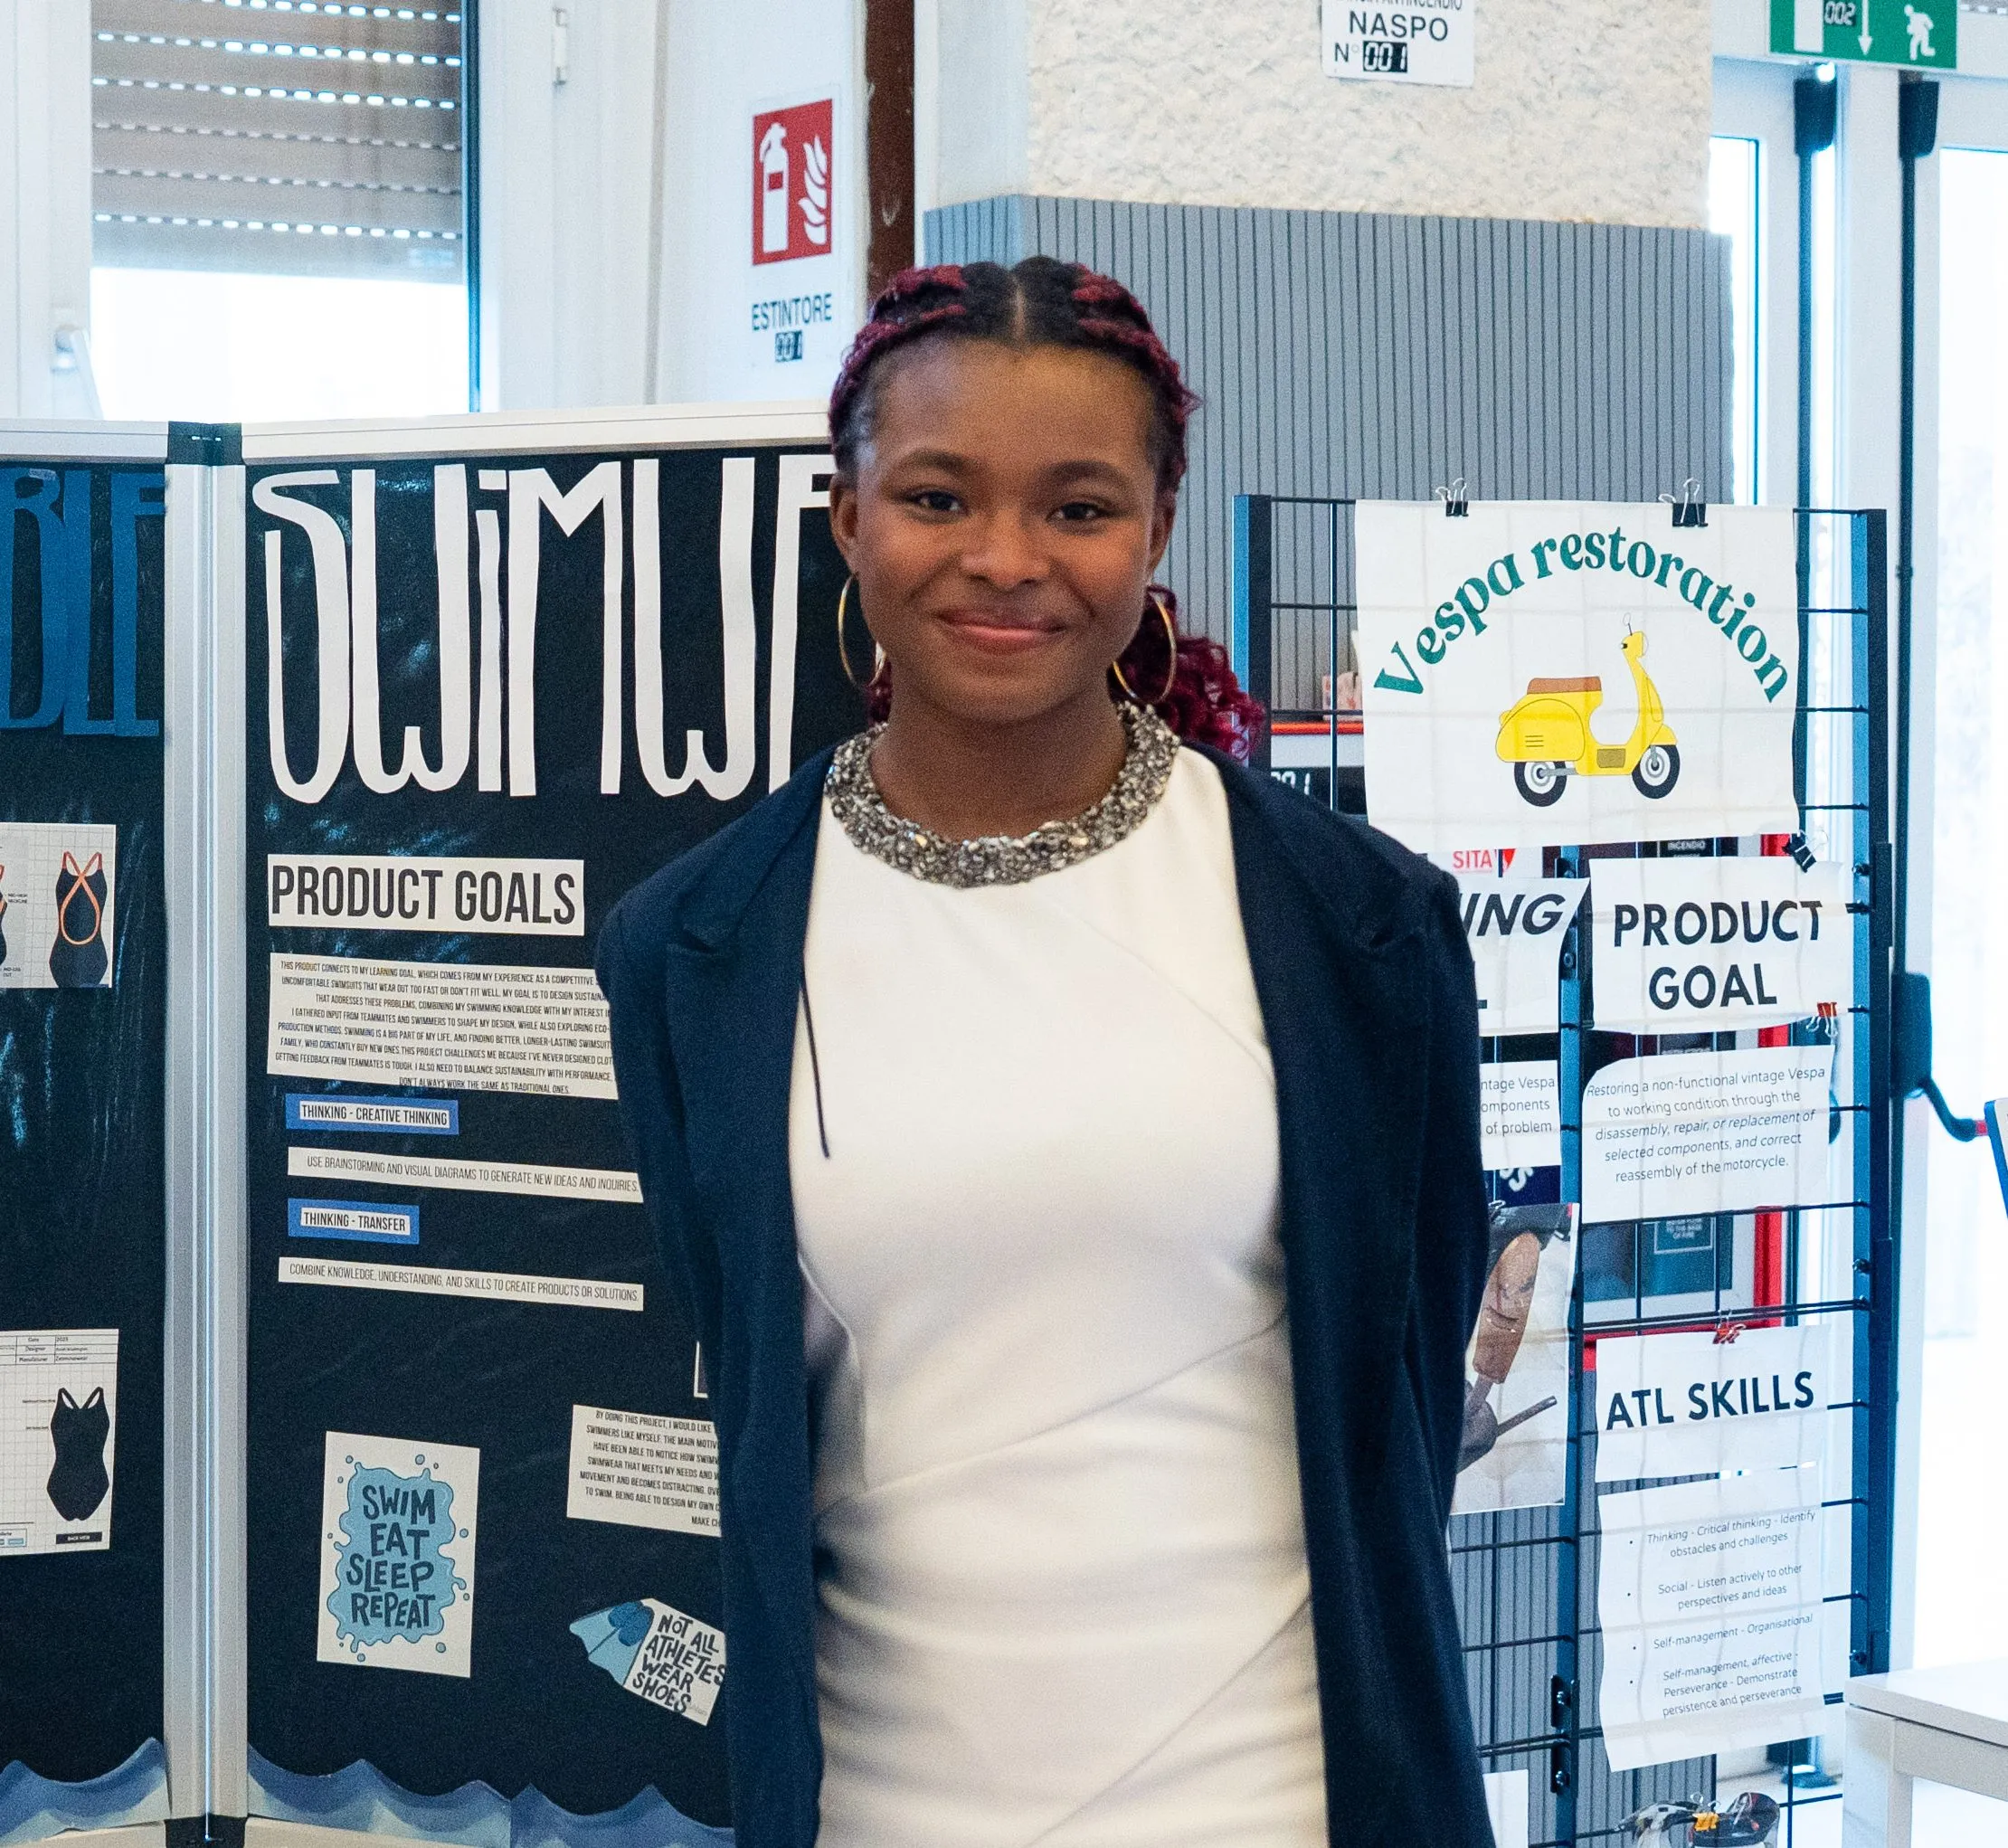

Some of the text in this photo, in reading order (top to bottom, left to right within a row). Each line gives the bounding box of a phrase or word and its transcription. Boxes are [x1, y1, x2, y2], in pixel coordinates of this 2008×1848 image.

[1350, 11, 1448, 42] NASPO
[1824, 1, 1856, 25] 002
[1364, 42, 1407, 72] 001
[752, 293, 832, 331] ESTINTORE
[1373, 526, 1789, 703] Vespa restoration
[271, 865, 576, 925] PRODUCT GOALS
[1458, 893, 1566, 937] ING
[1614, 900, 1823, 947] PRODUCT
[1649, 963, 1777, 1010] GOAL
[1519, 1076, 1555, 1091] Vespa
[1587, 1067, 1825, 1096] Restoring a non-functional vintage Vespa
[302, 1104, 448, 1125] THINKING CREATIVE THINKING
[1481, 1100, 1550, 1114] omponents
[1607, 1089, 1801, 1117] to working condition through the
[1485, 1120, 1552, 1137] of problem
[1596, 1109, 1816, 1141] disassembly, repair, or replacement of
[1605, 1133, 1802, 1161] selected components, and correct
[307, 1155, 322, 1168] USE
[386, 1163, 403, 1175] AND
[403, 1165, 432, 1177] VISUAL
[435, 1166, 477, 1180] DIAGRAMS
[479, 1170, 489, 1181] TO
[490, 1170, 532, 1184] GENERATE
[534, 1173, 553, 1186] NEW
[554, 1175, 578, 1188] IDEAS
[579, 1177, 597, 1189] AND
[1615, 1154, 1789, 1182] reassembly of the motorcycle.
[304, 1211, 406, 1231] THINKING TRANSFER
[289, 1263, 326, 1277] COMBINE
[445, 1275, 463, 1288] AND
[464, 1277, 492, 1290] SKILLS
[493, 1279, 504, 1291] TO
[506, 1281, 536, 1294] CREATE
[537, 1283, 580, 1297] PRODUCTS
[582, 1285, 592, 1298] OR
[1605, 1370, 1814, 1431] ATL SKILLS
[586, 1424, 620, 1438] SWIMMERS
[621, 1430, 634, 1440] LIKE
[664, 1436, 676, 1445] THE
[677, 1436, 695, 1446] MAIN
[595, 1410, 604, 1419] BY
[624, 1414, 639, 1425] THIS
[673, 1421, 696, 1432] WOULD
[697, 1423, 712, 1433] LIKE
[593, 1441, 610, 1452] HAVE
[611, 1444, 627, 1455] BEEN
[629, 1446, 644, 1456] ABLE
[646, 1448, 655, 1458] TO
[656, 1450, 678, 1461] NOTICE
[680, 1453, 695, 1462] HOW
[580, 1471, 615, 1483] MOVEMENT
[616, 1475, 630, 1485] AND
[630, 1477, 661, 1490] BECOMES
[588, 1456, 713, 1480] SWIMWEAR THAT MEETS MY NEEDS AND
[363, 1485, 436, 1524] SWIM
[585, 1486, 593, 1495] TO
[615, 1490, 634, 1502] BEING
[635, 1493, 651, 1504] ABLE
[653, 1495, 661, 1505] TO
[662, 1497, 686, 1508] DESIGN
[687, 1500, 697, 1509] MY
[698, 1502, 715, 1512] OWN
[691, 1516, 709, 1526] MAKE
[1647, 1511, 1816, 1544] Thinking Critical thinking Identify
[370, 1521, 430, 1559] EAT
[1670, 1532, 1788, 1558] obstacles and challenges
[346, 1553, 434, 1592] SLEEP
[1658, 1564, 1802, 1595] Social Listen actively to other
[351, 1592, 436, 1629] REPEAT
[1678, 1584, 1787, 1611] perspectives and ideas
[658, 1614, 719, 1656] NOT ALL
[1653, 1614, 1814, 1649] Self-management Organisational
[641, 1654, 694, 1693] WEAR
[645, 1635, 725, 1686] ATHLETES
[1751, 1652, 1793, 1666] affective
[632, 1673, 692, 1713] SHOES
[1664, 1668, 1798, 1698] Perseverance Demonstrate
[1662, 1685, 1802, 1719] persistence and perseverance
